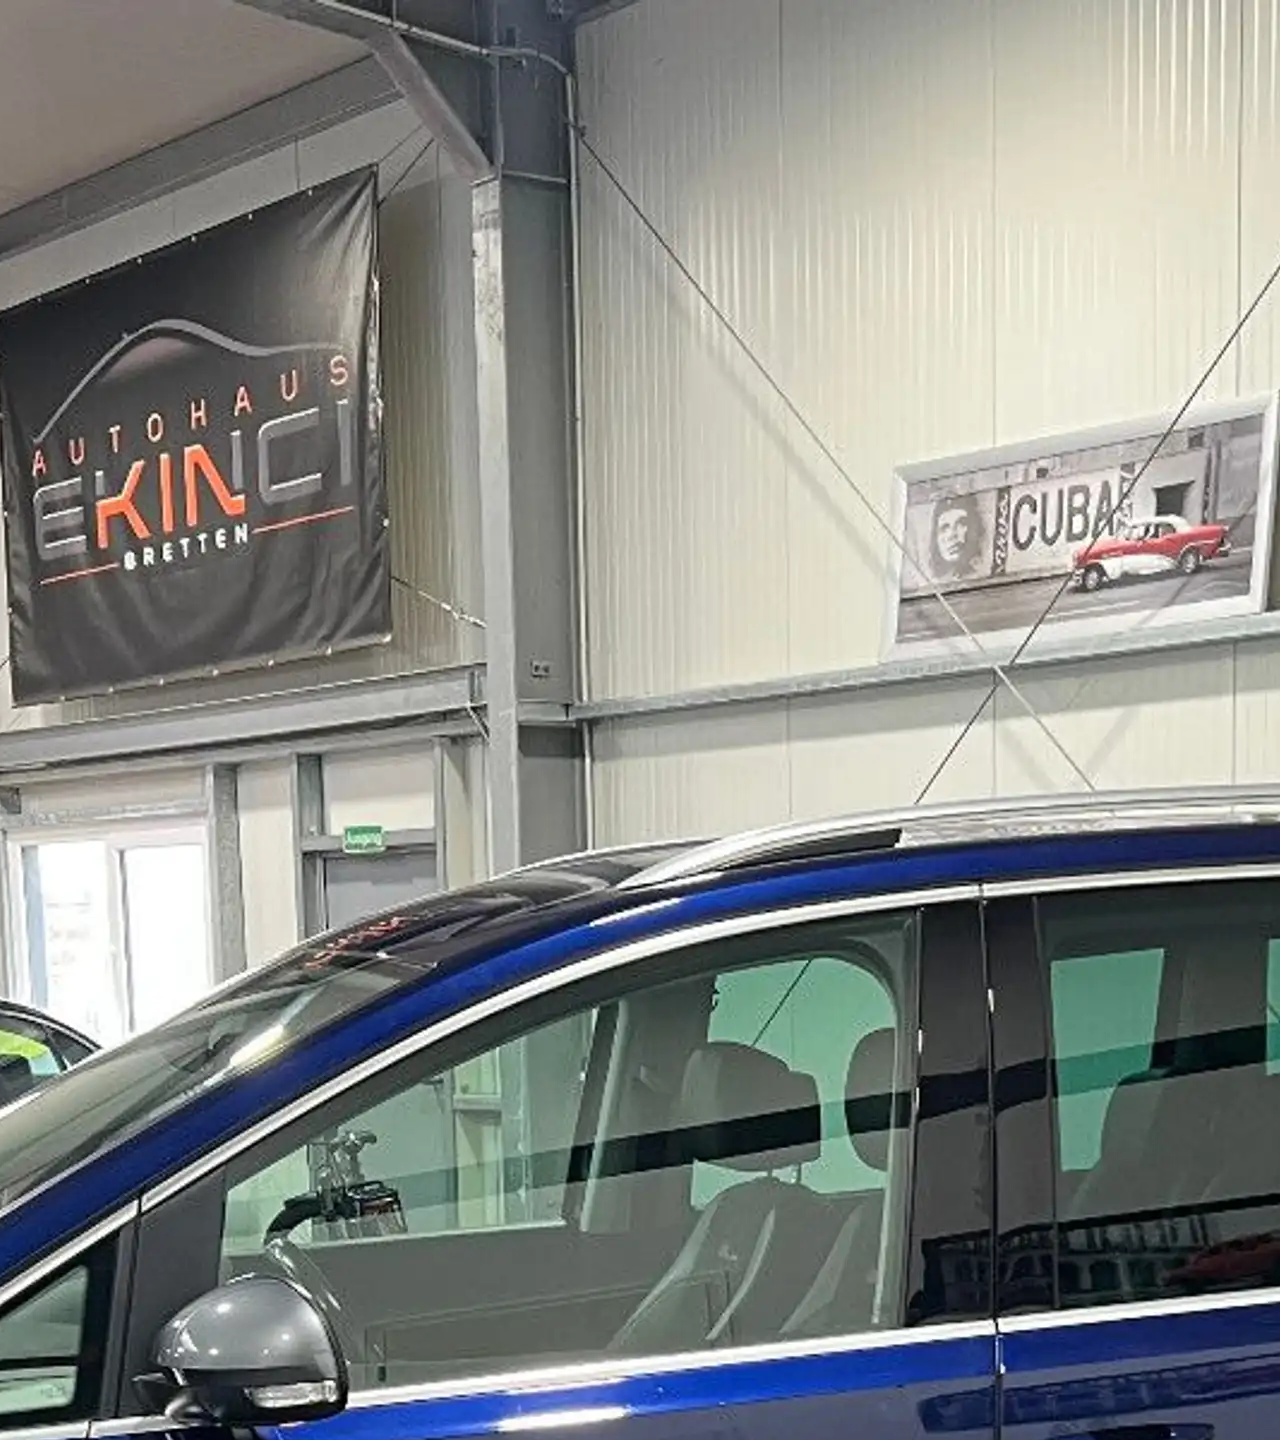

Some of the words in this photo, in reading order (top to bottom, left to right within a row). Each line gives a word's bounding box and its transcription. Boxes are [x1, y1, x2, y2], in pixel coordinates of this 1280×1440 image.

[32, 354, 349, 477] AUTOHAUS
[33, 398, 353, 561] EKINCI
[1012, 479, 1115, 551] CUBA
[123, 522, 249, 570] BRETTEN
